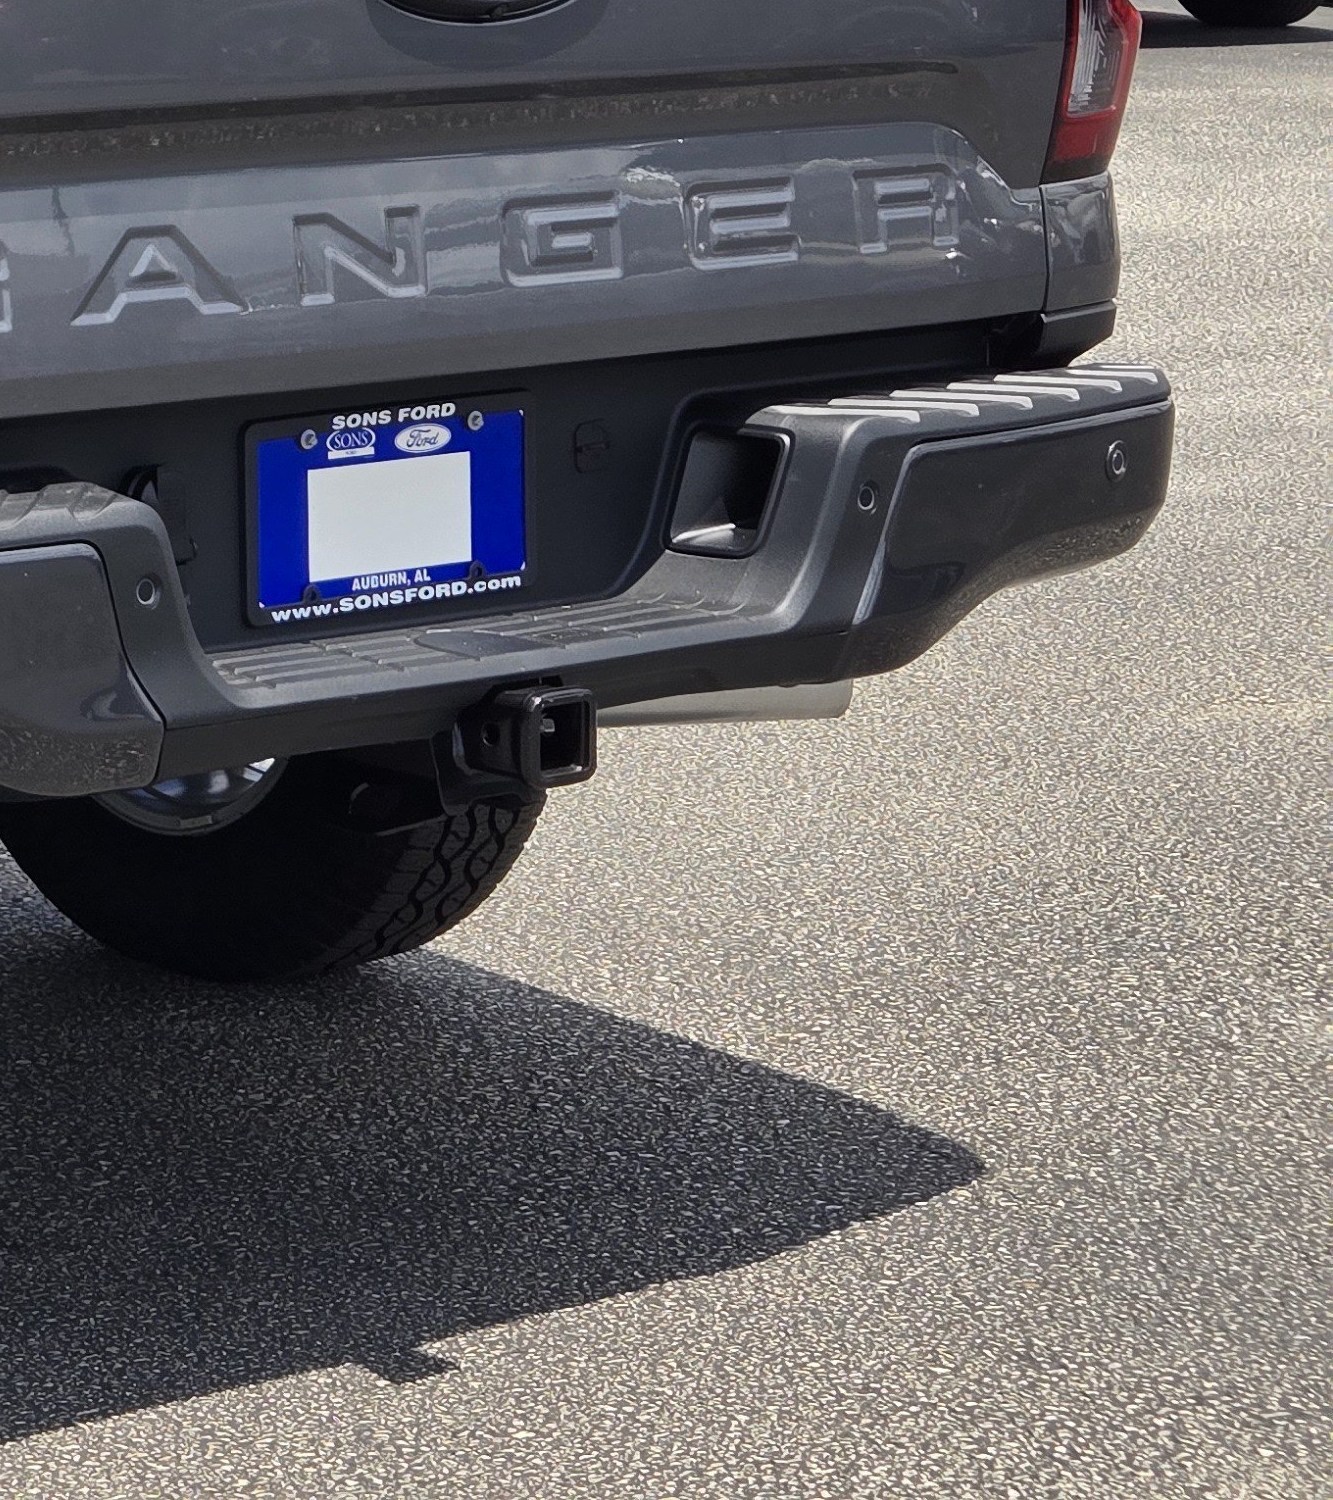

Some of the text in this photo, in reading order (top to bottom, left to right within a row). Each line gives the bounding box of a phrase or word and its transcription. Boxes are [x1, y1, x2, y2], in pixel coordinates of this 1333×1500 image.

[331, 402, 456, 430] SONS FORD
[334, 431, 369, 449] SONS
[406, 426, 441, 447] Ford
[352, 568, 432, 592] AUBURN, AL
[270, 575, 521, 623] www.SONSFORD.com
